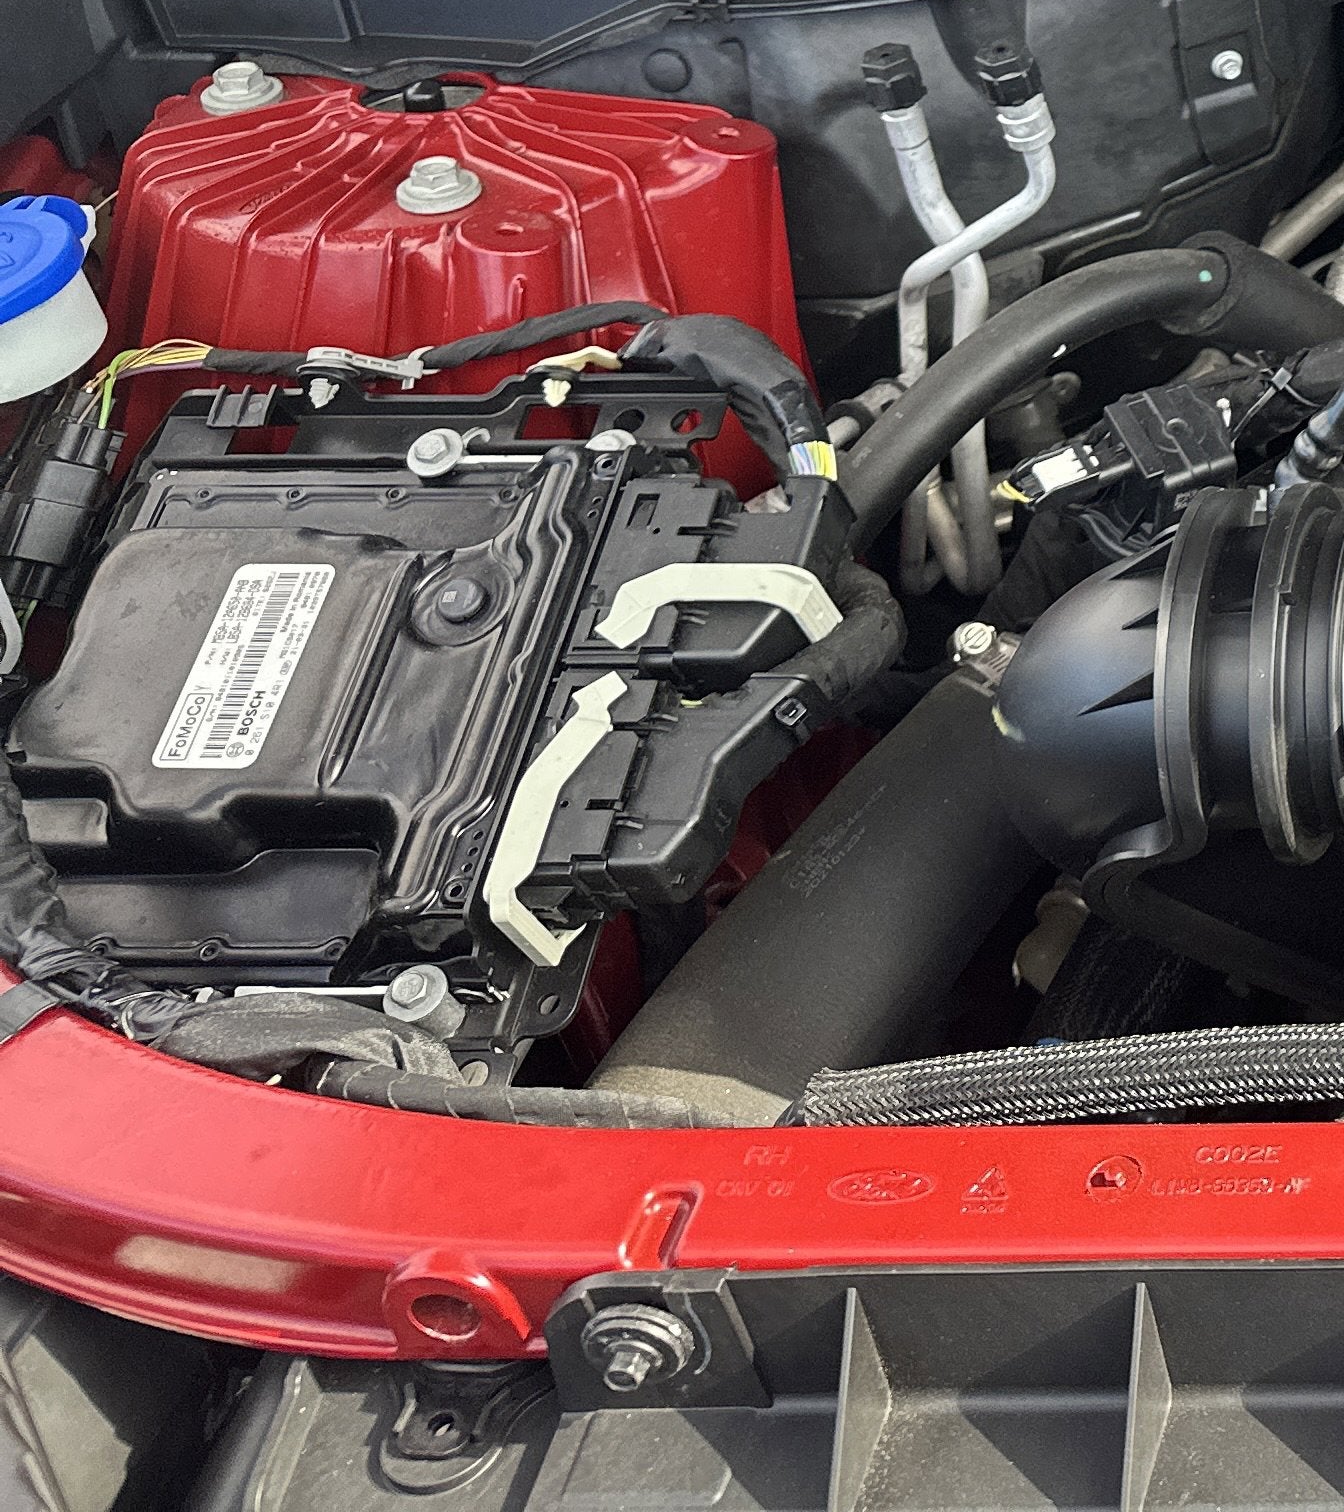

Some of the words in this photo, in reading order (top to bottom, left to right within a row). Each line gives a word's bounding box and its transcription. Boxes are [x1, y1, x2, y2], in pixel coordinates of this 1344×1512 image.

[166, 696, 207, 757] FoMoCo
[236, 690, 265, 735] BOSCH
[743, 1144, 792, 1166] RH
